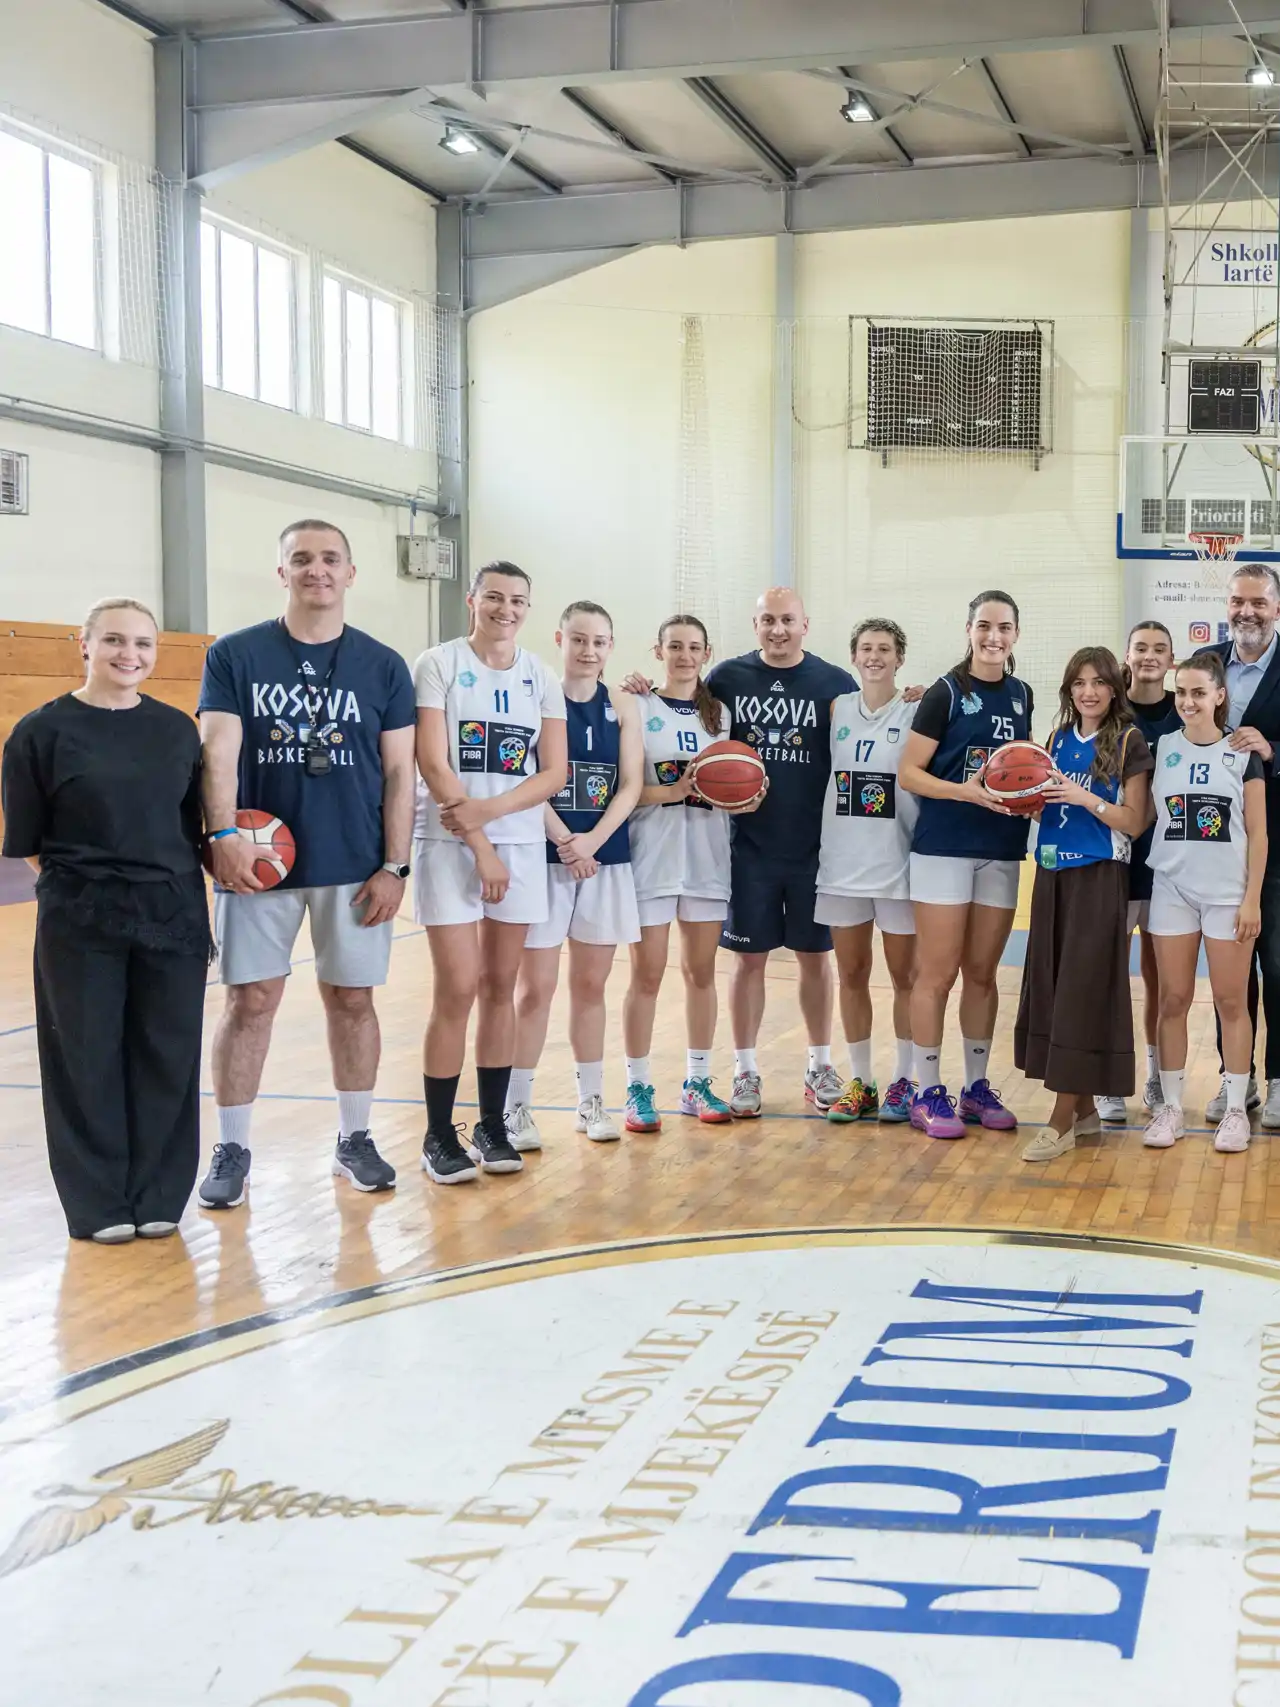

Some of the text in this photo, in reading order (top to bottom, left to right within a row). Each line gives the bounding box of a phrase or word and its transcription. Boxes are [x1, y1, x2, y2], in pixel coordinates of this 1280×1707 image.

[1223, 264, 1273, 282] lartë
[1214, 388, 1235, 397] FAZI
[1191, 508, 1264, 523] Prioritti
[493, 689, 510, 714] 11
[734, 695, 818, 728] KOSOVA
[585, 725, 593, 751] 1
[991, 715, 1015, 741] 25
[676, 730, 699, 753] 19
[855, 739, 876, 763] 17
[258, 747, 355, 766] BASKEALL
[462, 750, 482, 760] FIBA
[752, 747, 811, 764] KETBALL
[1189, 763, 1210, 785] 13
[1059, 804, 1070, 829] 5
[490, 1326, 715, 1493] MESME
[570, 1308, 840, 1558] MJEKËSISË
